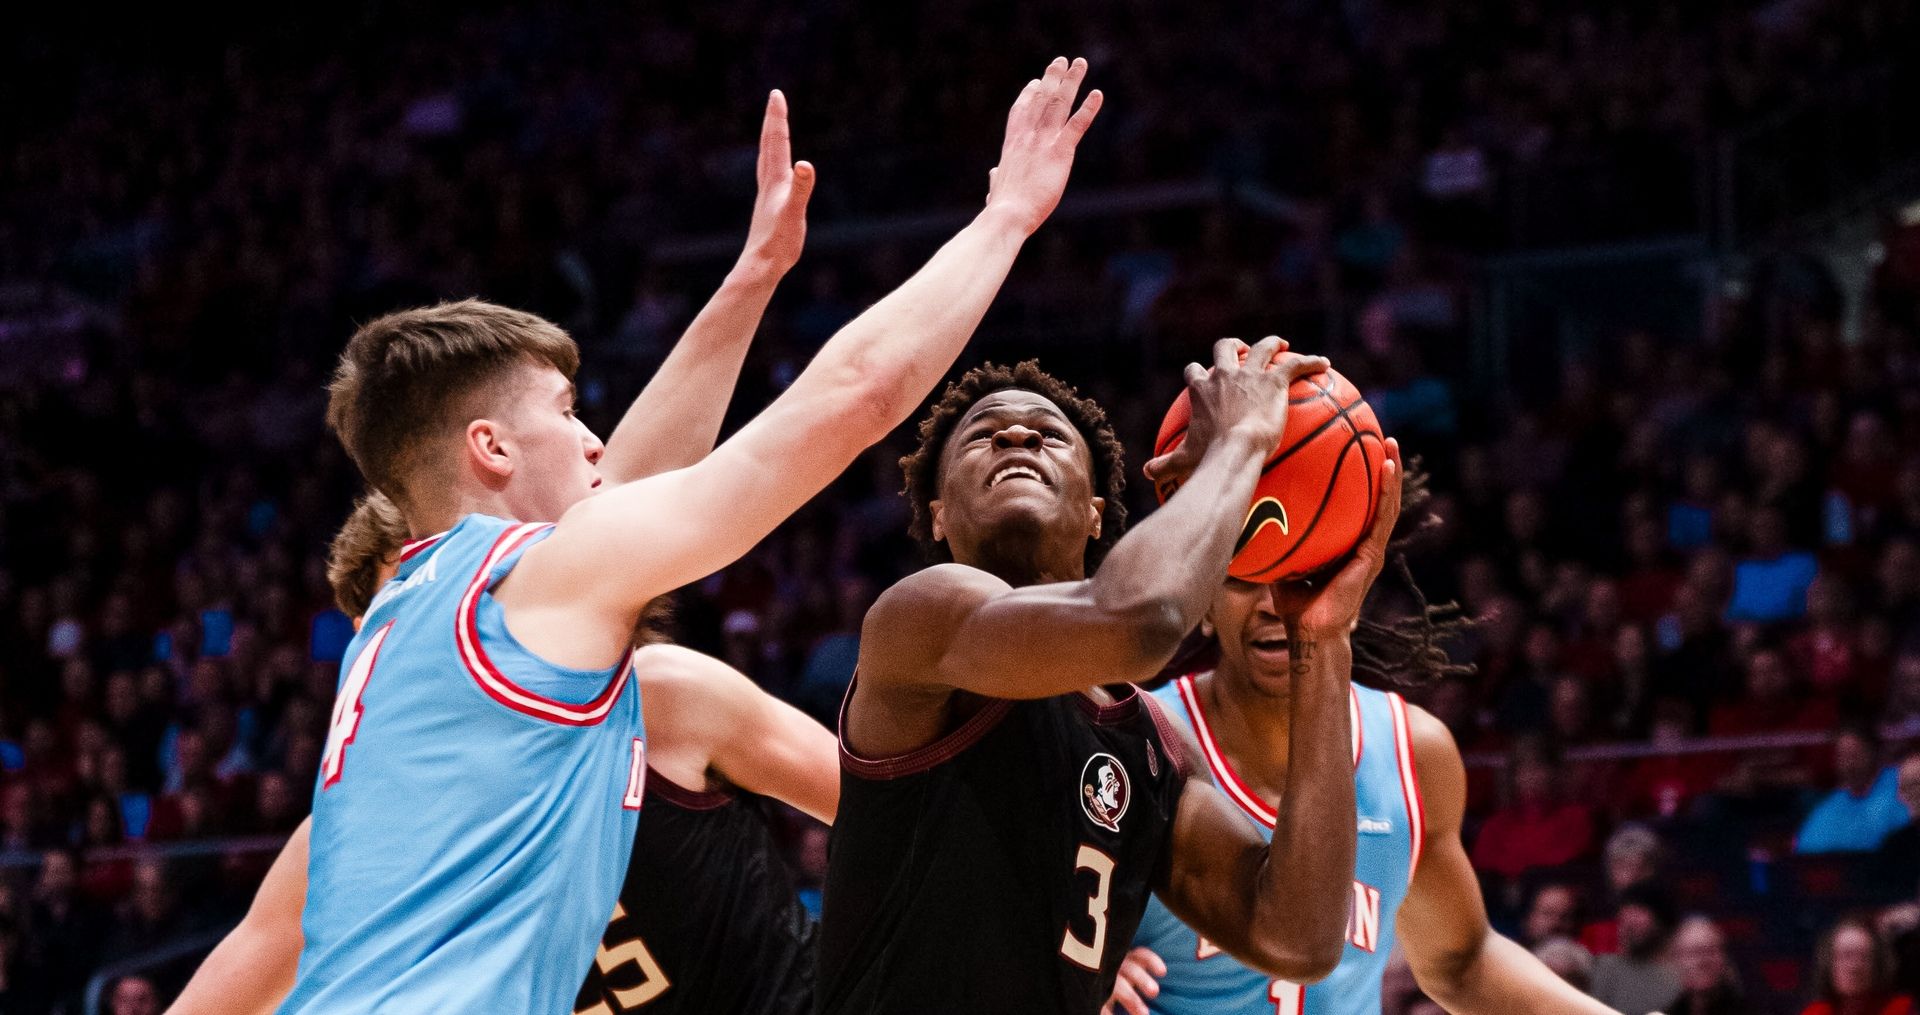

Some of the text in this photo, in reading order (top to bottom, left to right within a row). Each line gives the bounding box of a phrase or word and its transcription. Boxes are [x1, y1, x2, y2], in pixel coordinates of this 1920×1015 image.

[322, 618, 398, 791] 4
[572, 898, 672, 1015] 5
[1060, 843, 1118, 973] 3
